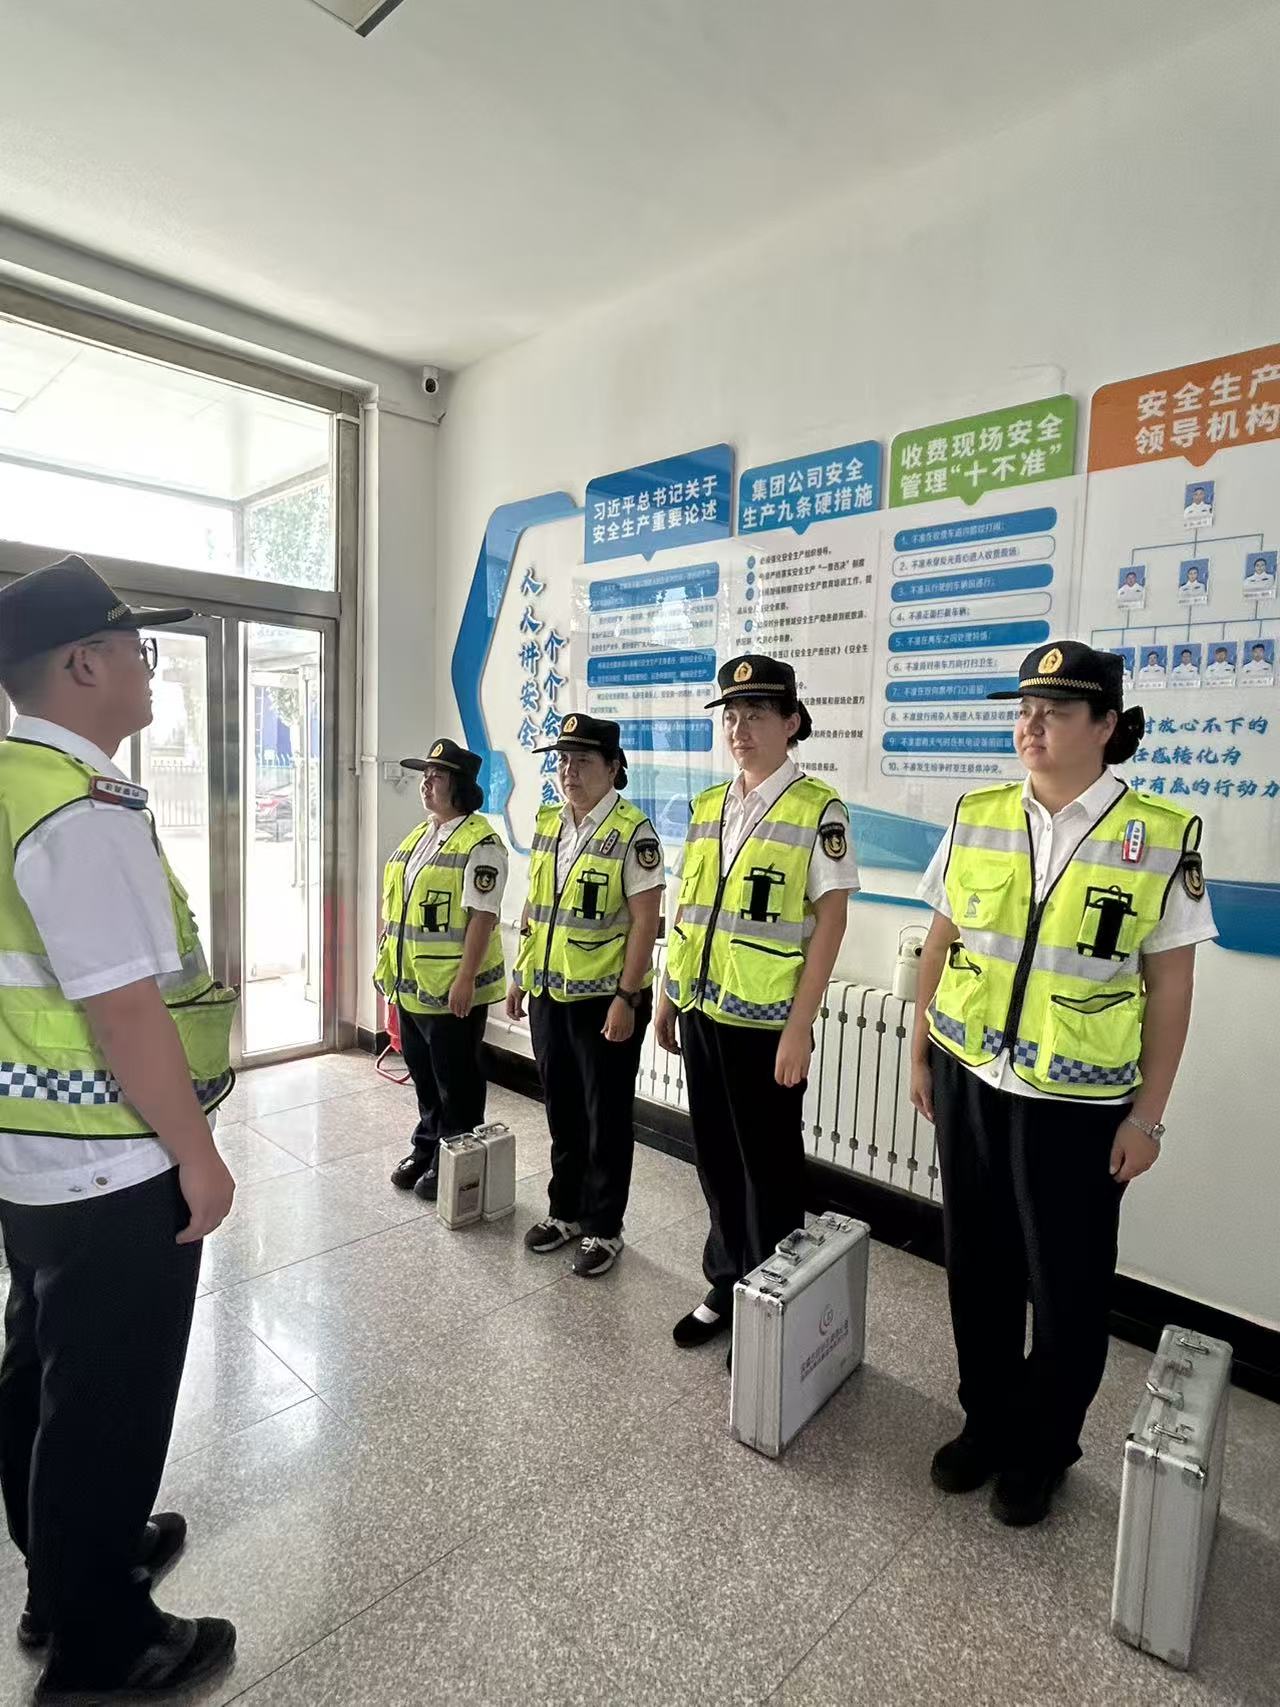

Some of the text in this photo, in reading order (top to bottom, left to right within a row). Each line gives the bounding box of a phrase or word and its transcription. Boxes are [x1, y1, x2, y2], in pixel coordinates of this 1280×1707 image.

[1136, 363, 1280, 421] 安全生产
[901, 412, 1064, 470] 收费现场安全
[1134, 401, 1280, 455] 领导机构
[593, 474, 718, 520] 习近平总书记关于
[751, 457, 864, 502] 集团公司安全
[900, 443, 1063, 499] 管理“十不准”
[592, 499, 718, 544] 安全生产重要论述
[742, 482, 873, 529] 生产九条硬措施
[518, 567, 546, 750] 人人讲安全
